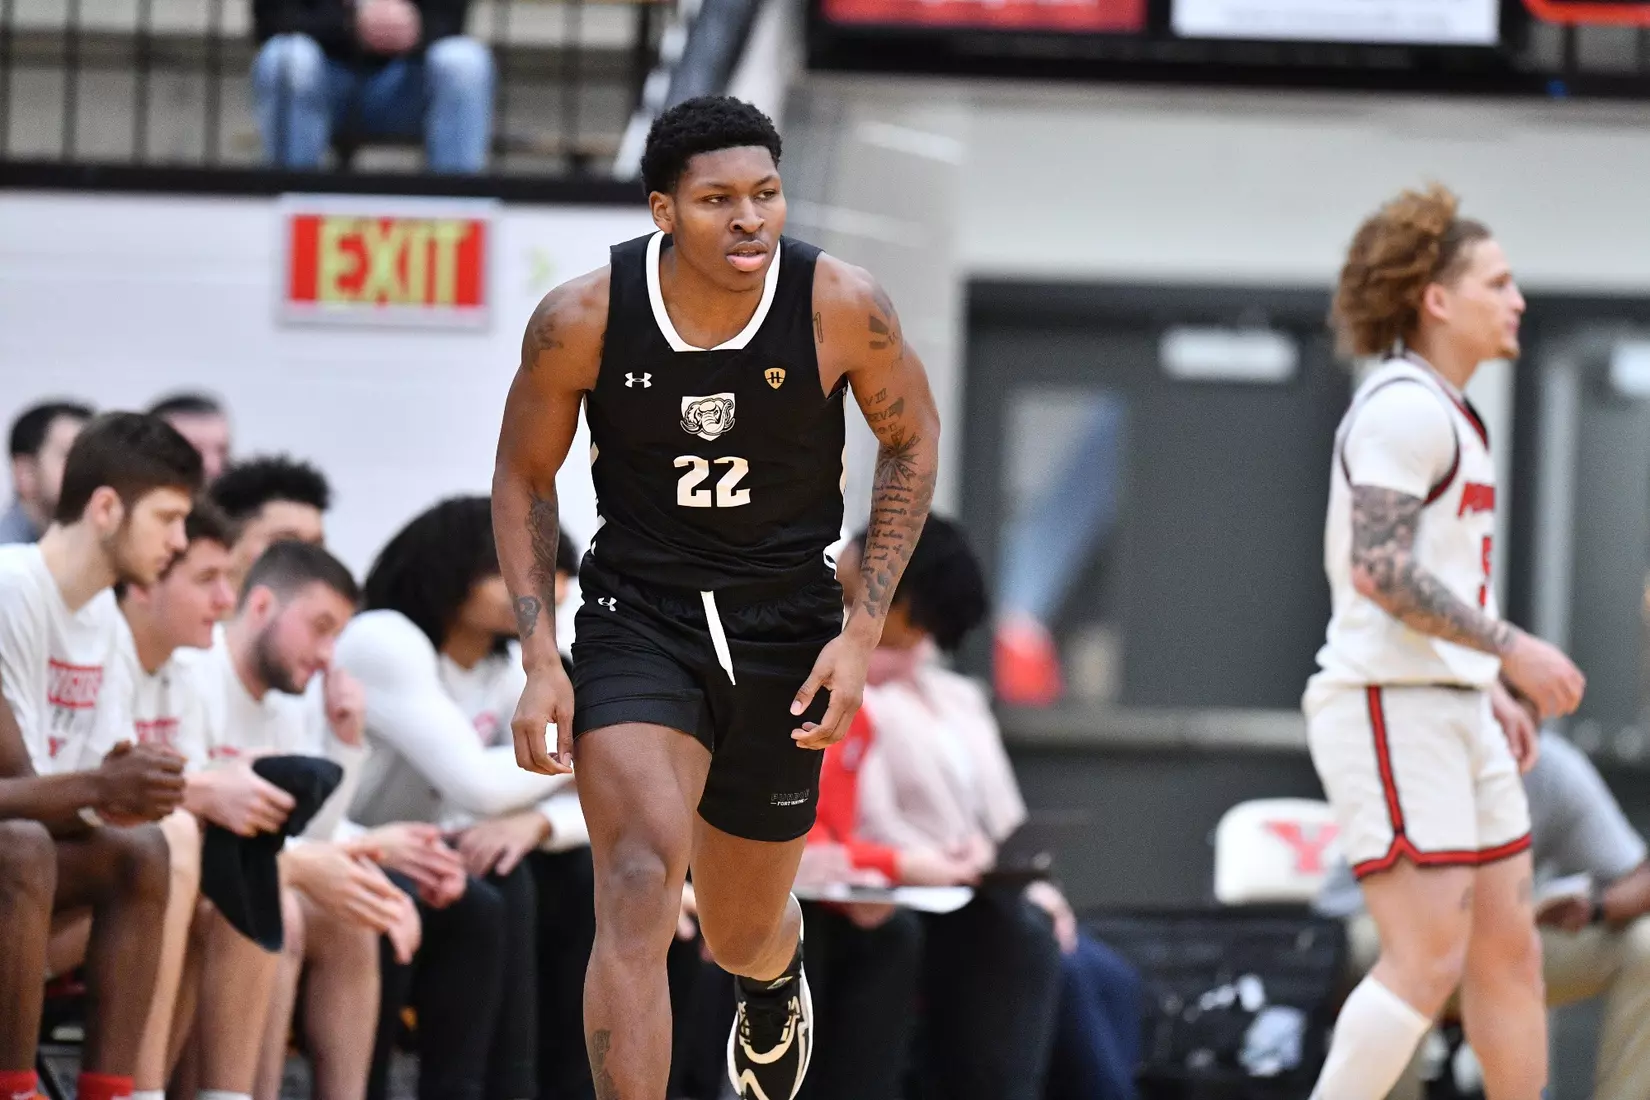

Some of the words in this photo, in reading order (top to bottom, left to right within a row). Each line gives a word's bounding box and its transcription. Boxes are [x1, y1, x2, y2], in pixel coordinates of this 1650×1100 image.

[319, 214, 471, 307] EXIT
[673, 455, 751, 508] 22
[1263, 821, 1341, 873] Y
